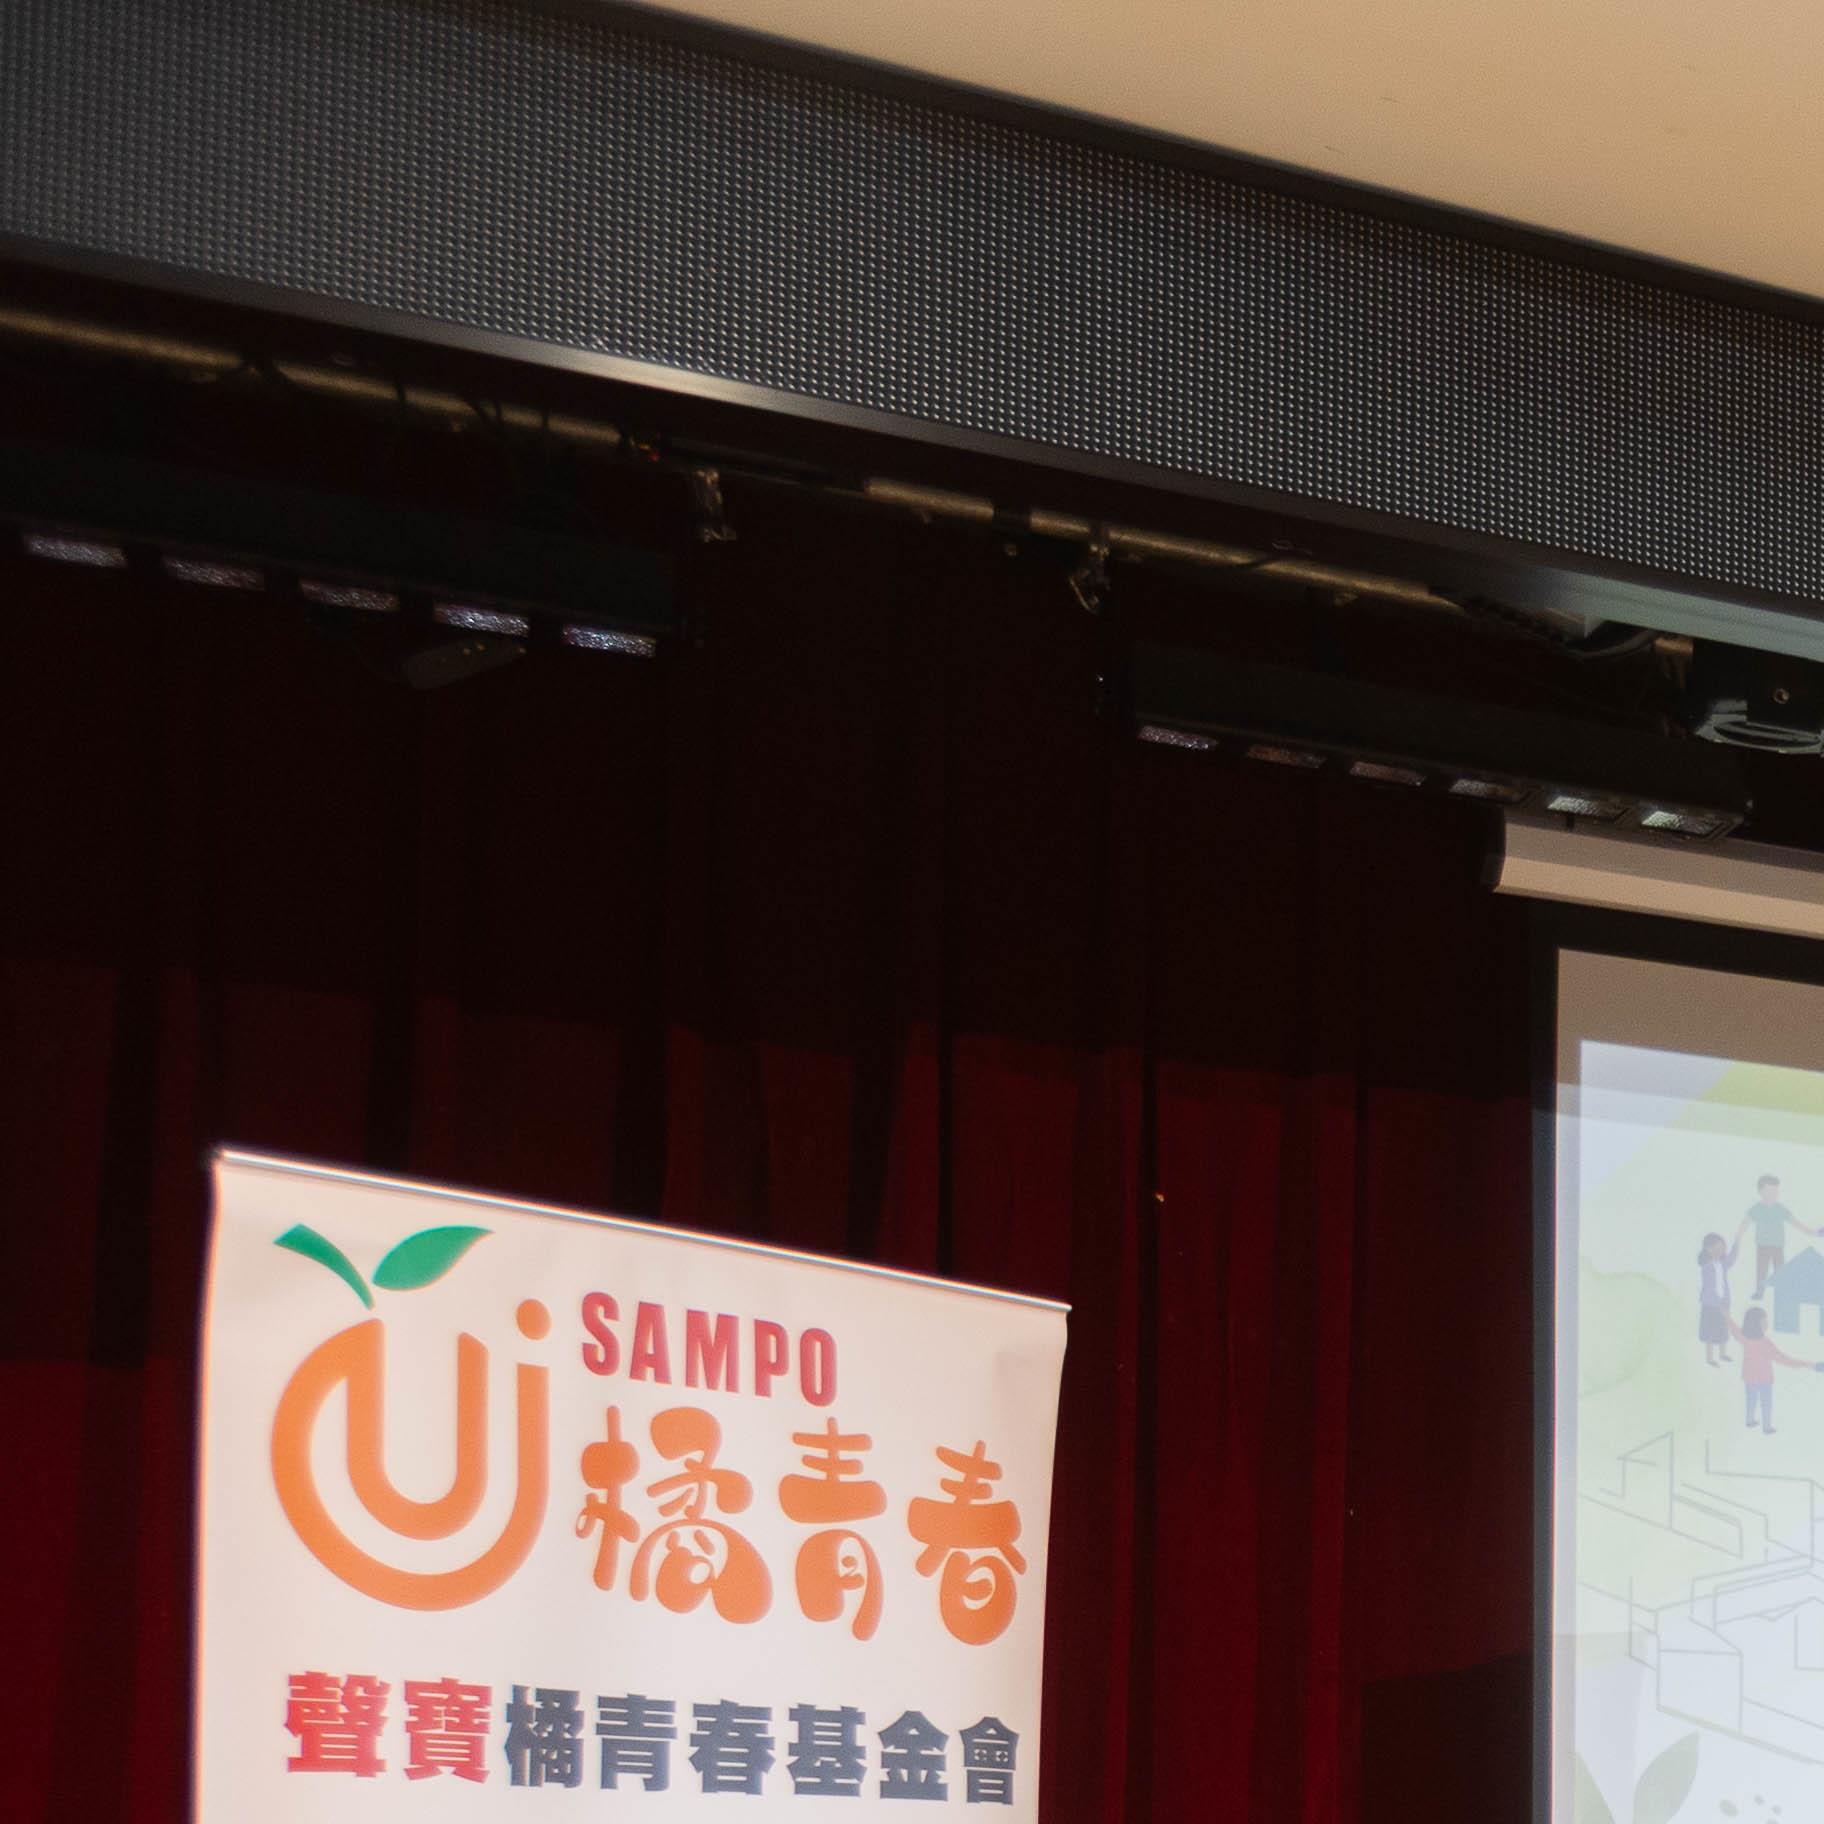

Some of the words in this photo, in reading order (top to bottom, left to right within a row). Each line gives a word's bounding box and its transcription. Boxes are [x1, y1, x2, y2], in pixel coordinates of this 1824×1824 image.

[580, 1291, 838, 1407] SAMPO
[575, 1405, 1028, 1646] 橘青春
[285, 1669, 1020, 1807] 聲寶橘青春基金會
